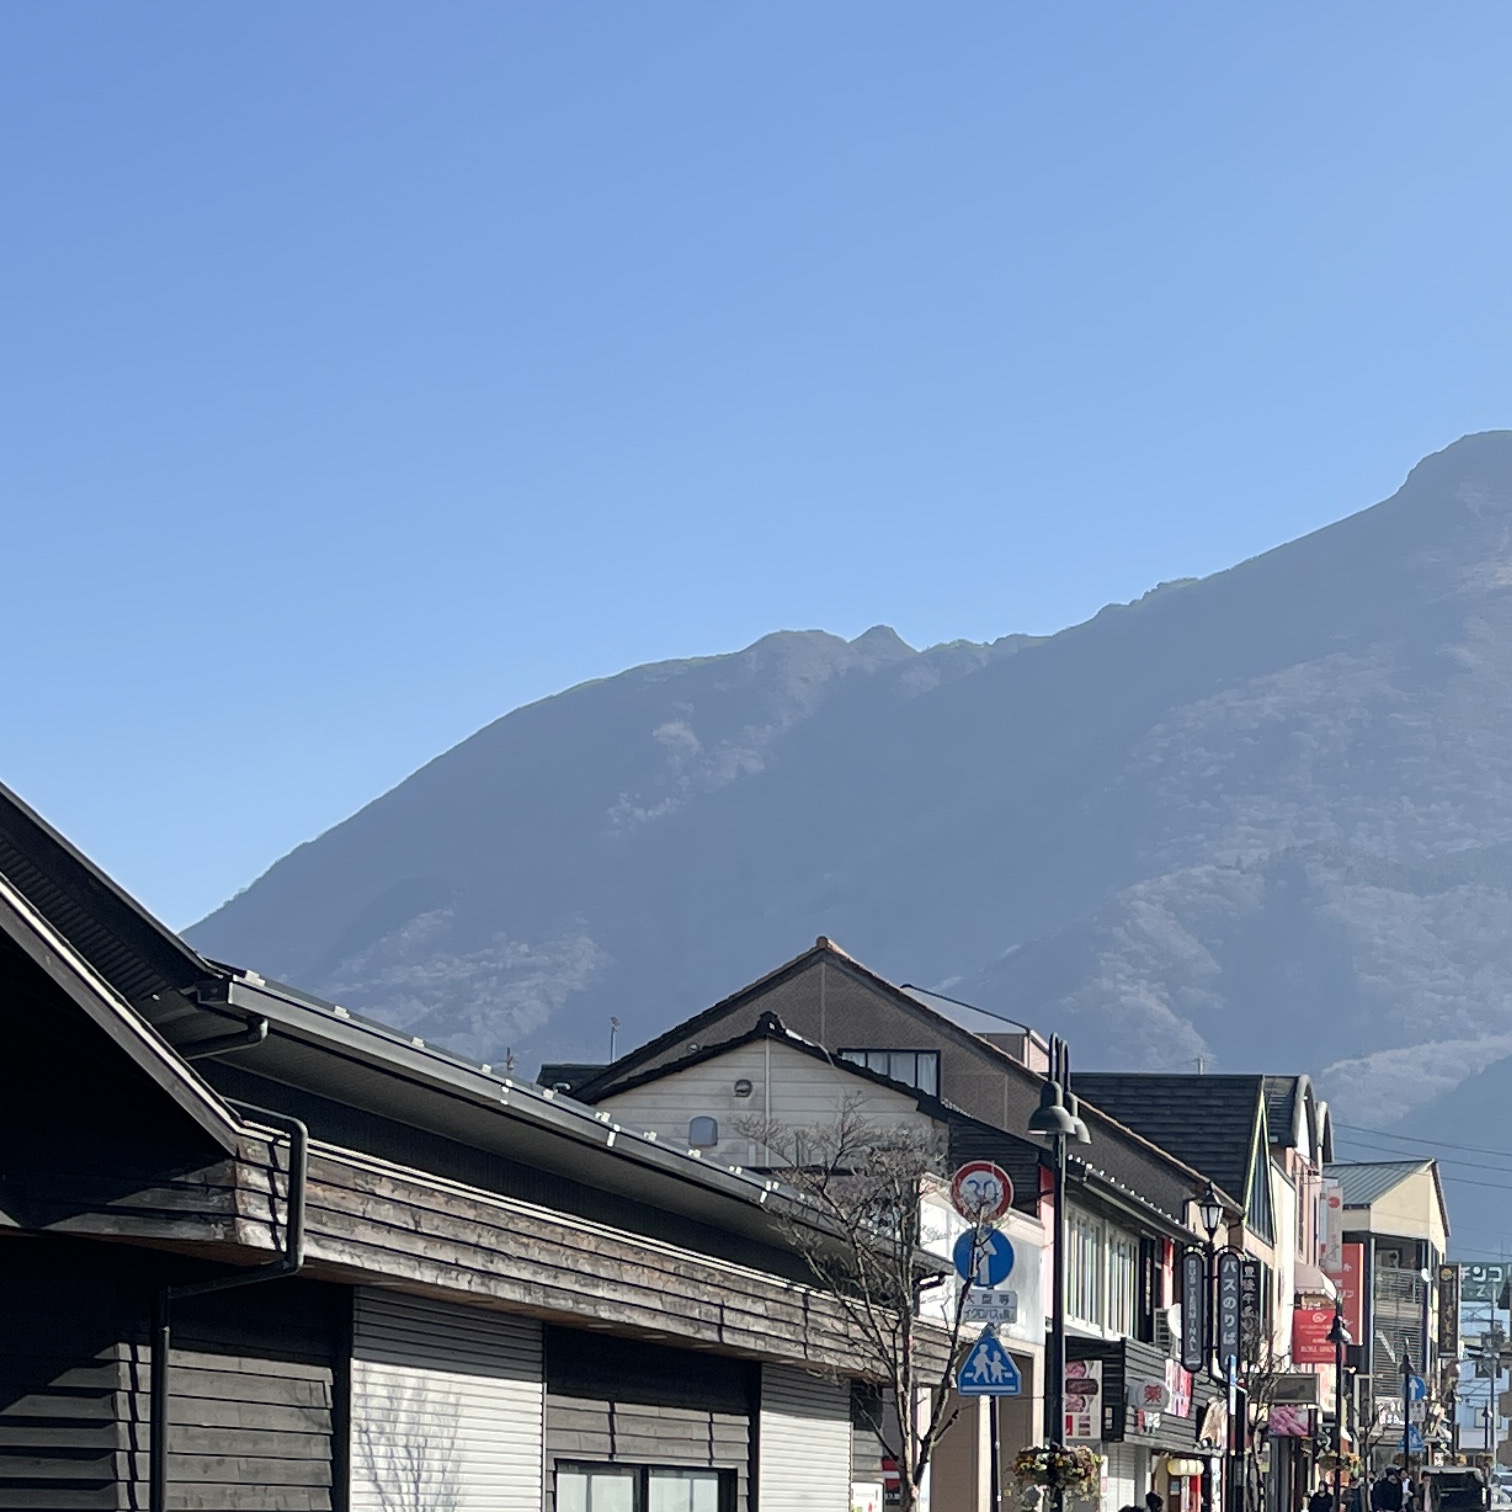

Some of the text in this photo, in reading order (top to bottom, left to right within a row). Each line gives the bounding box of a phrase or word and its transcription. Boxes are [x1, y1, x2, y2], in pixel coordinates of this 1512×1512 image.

[967, 1179, 997, 1201] 30
[1188, 1260, 1197, 1351] BUS TERMINAL
[1223, 1261, 1237, 1345] バスのりば
